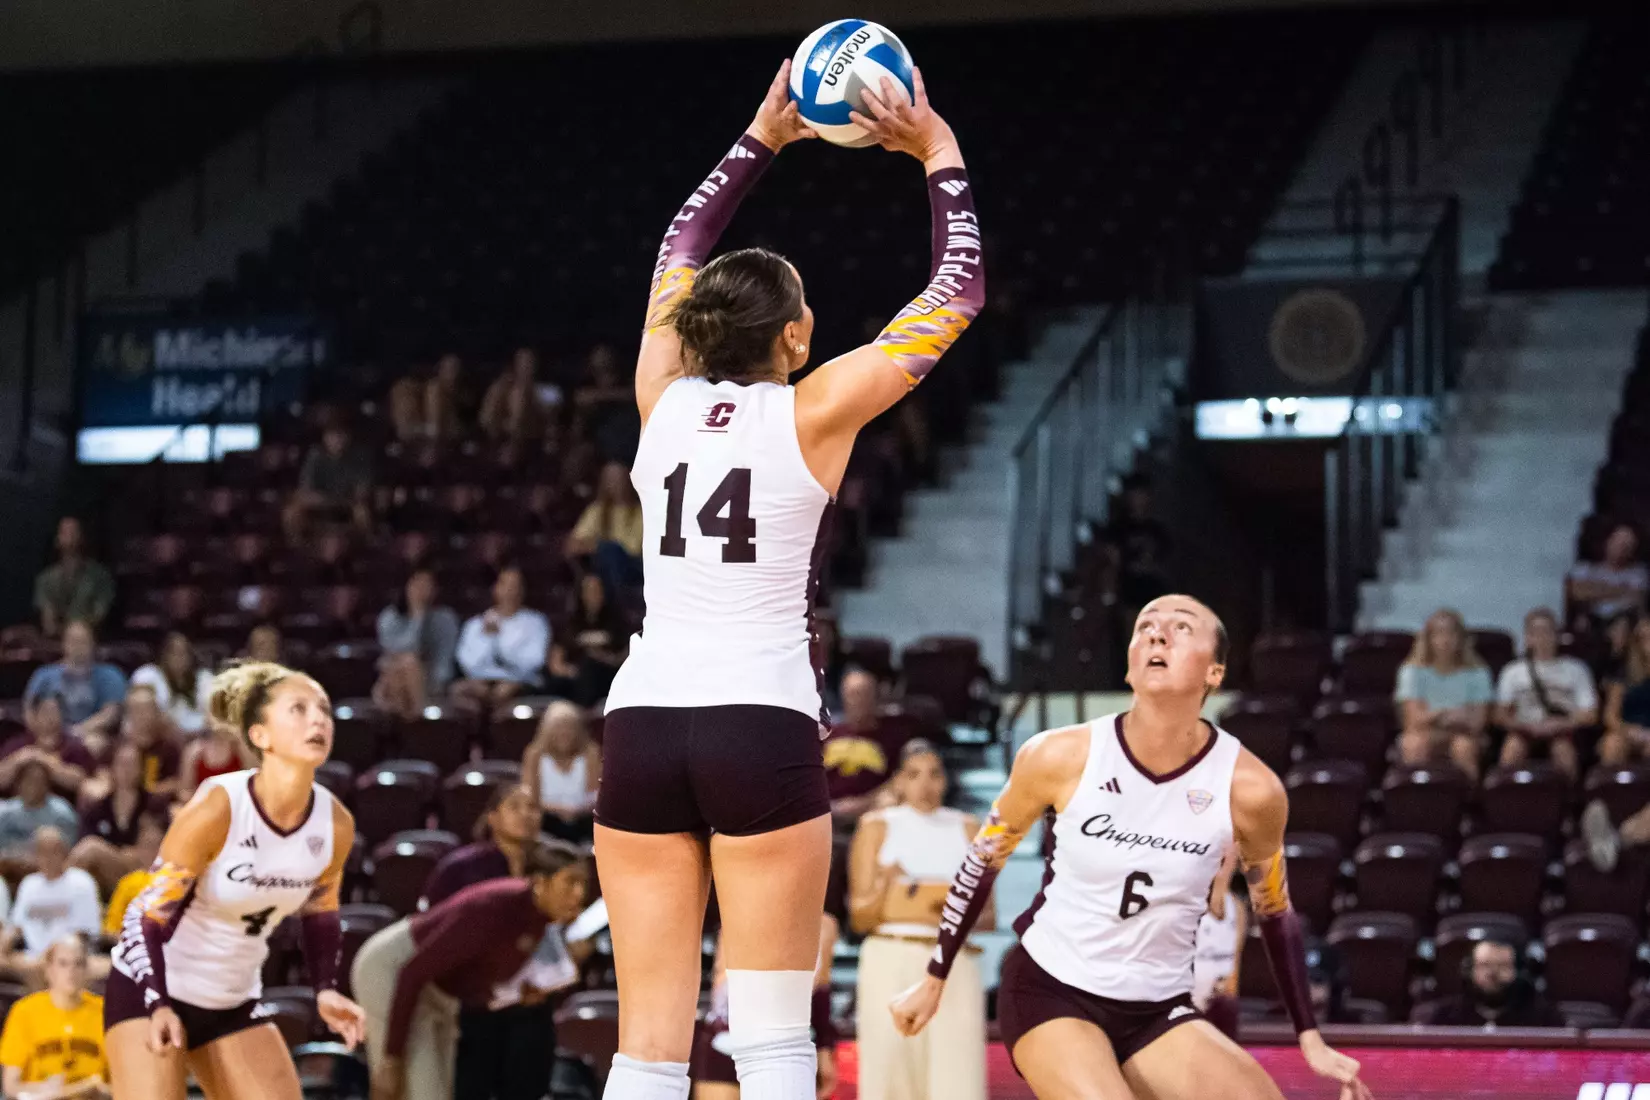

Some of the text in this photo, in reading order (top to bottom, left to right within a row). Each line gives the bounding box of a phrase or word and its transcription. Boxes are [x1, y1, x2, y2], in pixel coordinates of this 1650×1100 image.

[824, 30, 871, 87] molten
[906, 210, 981, 315] CHIPPEWAS
[659, 462, 756, 563] 14
[1081, 813, 1211, 855] Chippewas
[241, 906, 277, 936] 4
[1119, 870, 1154, 920] 6
